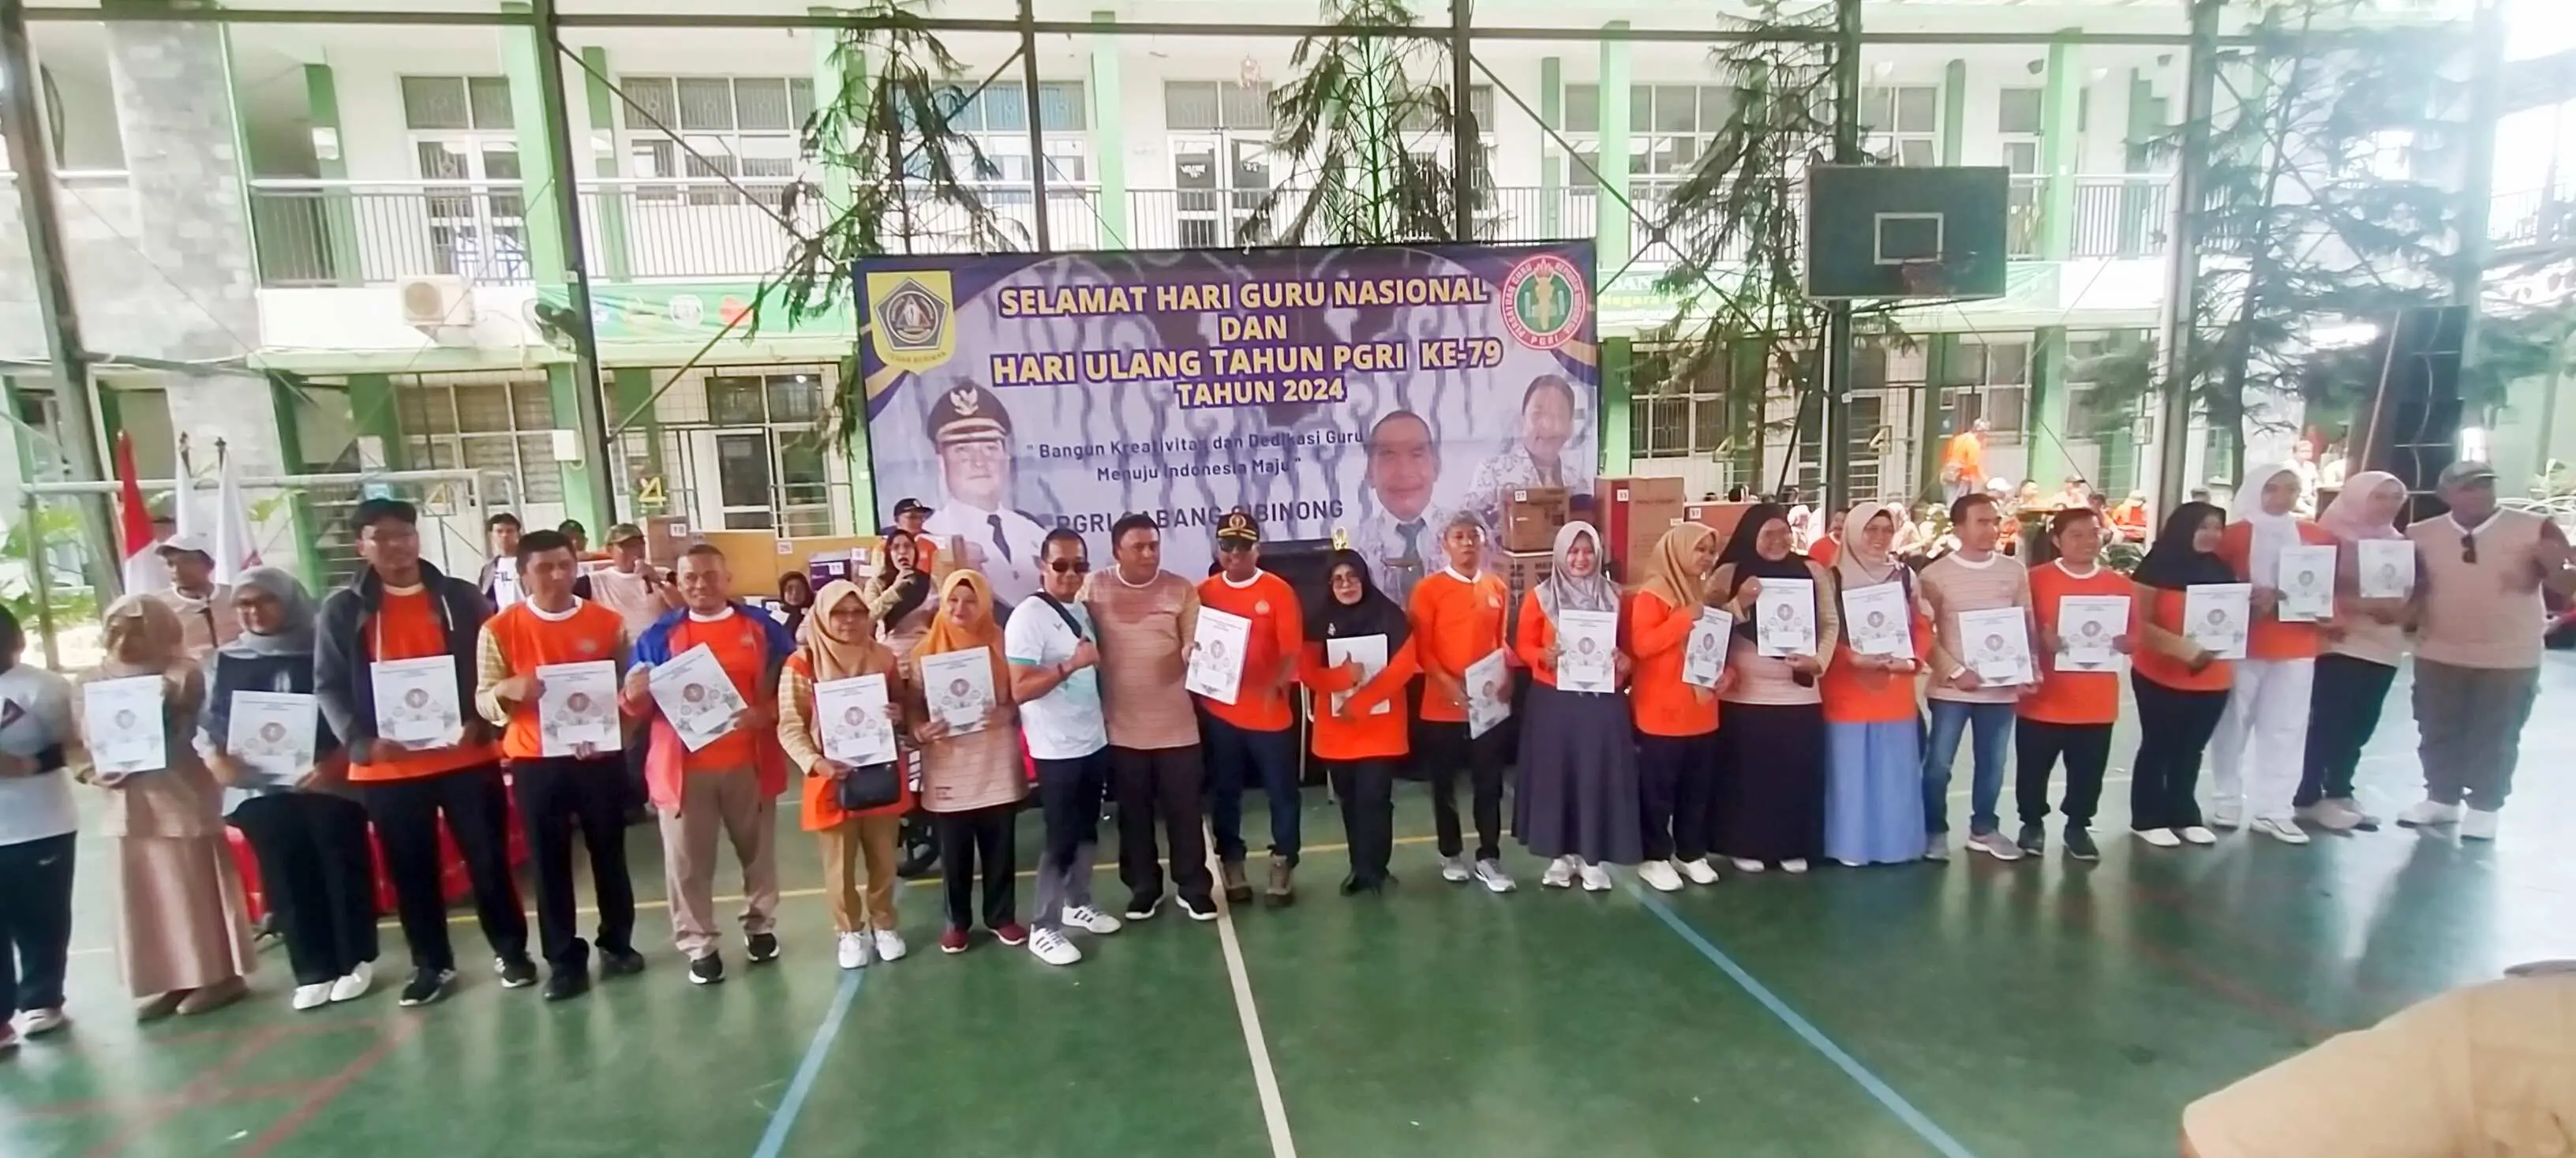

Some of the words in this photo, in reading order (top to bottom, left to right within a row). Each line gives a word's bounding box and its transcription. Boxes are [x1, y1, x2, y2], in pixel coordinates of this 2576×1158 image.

[1001, 287, 1148, 316] SELAMAT
[1156, 284, 1232, 311] HARI
[1239, 280, 1326, 309] GURU
[1334, 277, 1488, 306] NASIONAL
[1221, 314, 1288, 342] DAN
[1530, 335, 1559, 346] PGRI
[992, 354, 1076, 384] HARI
[1084, 350, 1201, 381] ULANG
[1210, 346, 1324, 376] TAHUN
[1333, 343, 1405, 371] PGRI
[1421, 339, 1503, 369] KE-79
[1176, 380, 1275, 407] TAHUN
[1282, 377, 1345, 403] 2024
[1039, 444, 1105, 460] Bangun
[1212, 435, 1243, 450] dan
[1248, 430, 1321, 448] Dedikasi
[1326, 429, 1364, 444] Guru
[1097, 465, 1159, 483] Menuju
[1163, 461, 1247, 478] Indonesia
[1252, 458, 1290, 475] Maju
[1056, 512, 1112, 534] PGRI
[1121, 505, 1222, 530] BANG
